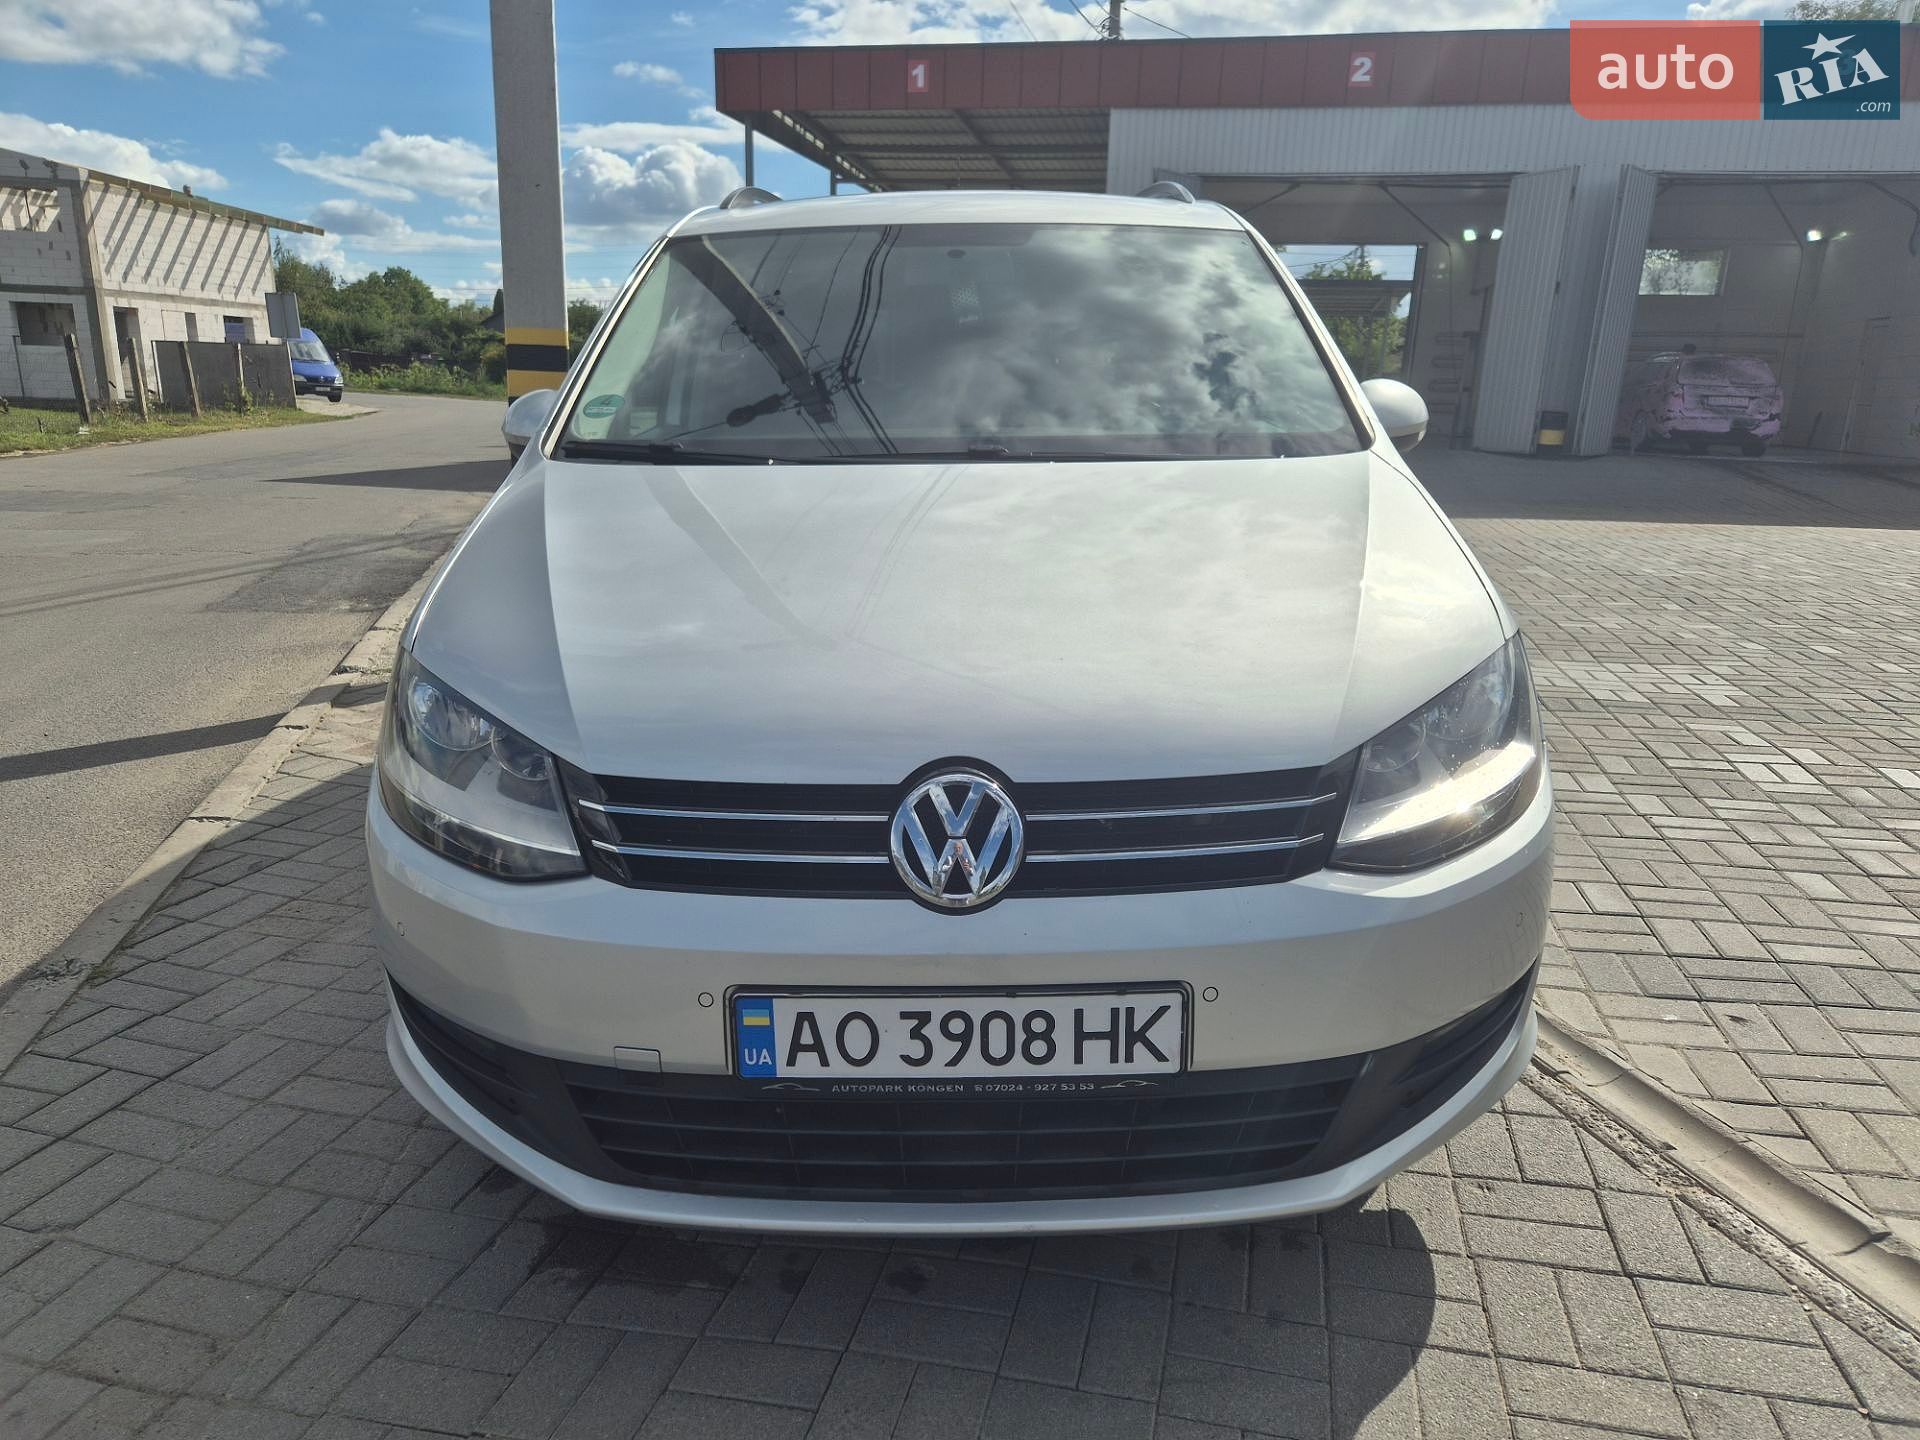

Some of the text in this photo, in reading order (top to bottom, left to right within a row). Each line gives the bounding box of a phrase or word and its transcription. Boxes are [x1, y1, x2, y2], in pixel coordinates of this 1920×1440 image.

[912, 63, 925, 88] 1
[1351, 56, 1372, 82] 2
[786, 1004, 1172, 1068] AO 3908 HK
[744, 1047, 772, 1066] UA
[832, 1084, 902, 1093] AUTOPARK
[985, 1083, 1023, 1092] 07024
[1034, 1083, 1057, 1092] 927
[1060, 1083, 1076, 1091] 53
[1079, 1082, 1095, 1090] 53
